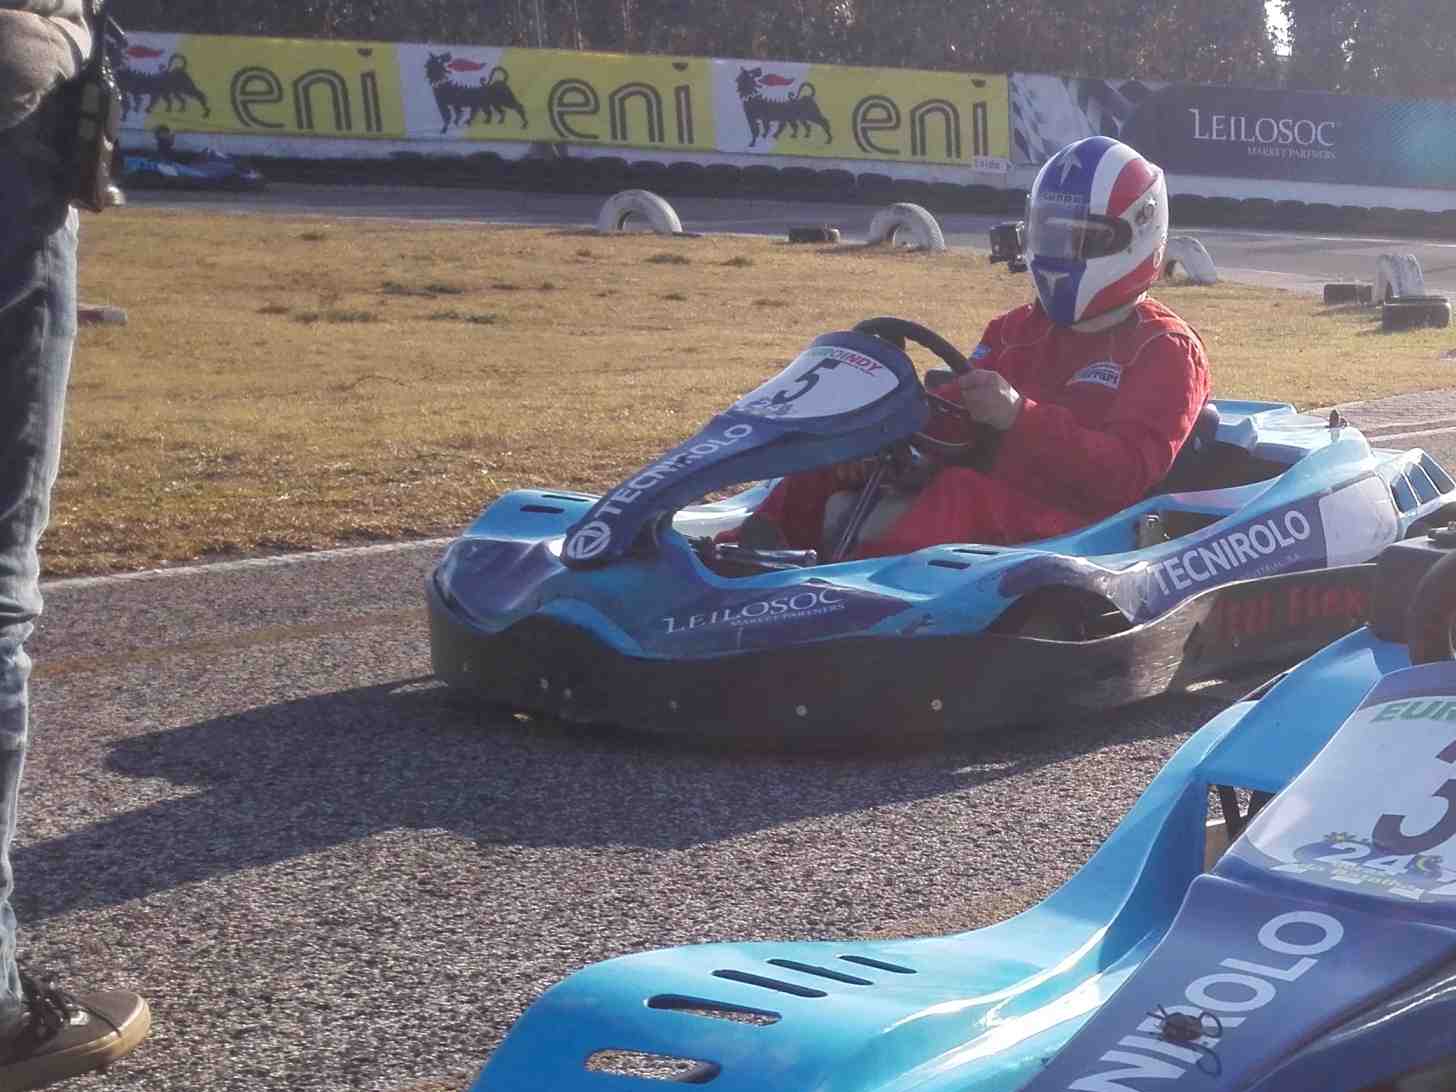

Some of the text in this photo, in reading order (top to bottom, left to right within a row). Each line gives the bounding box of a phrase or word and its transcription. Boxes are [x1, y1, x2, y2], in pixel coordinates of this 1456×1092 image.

[230, 48, 383, 133] eni
[547, 62, 695, 145] eni
[851, 78, 988, 159] eni
[1188, 107, 1337, 147] LEILOSOC
[771, 357, 843, 405] 5
[1146, 509, 1312, 598] TECNIROLO
